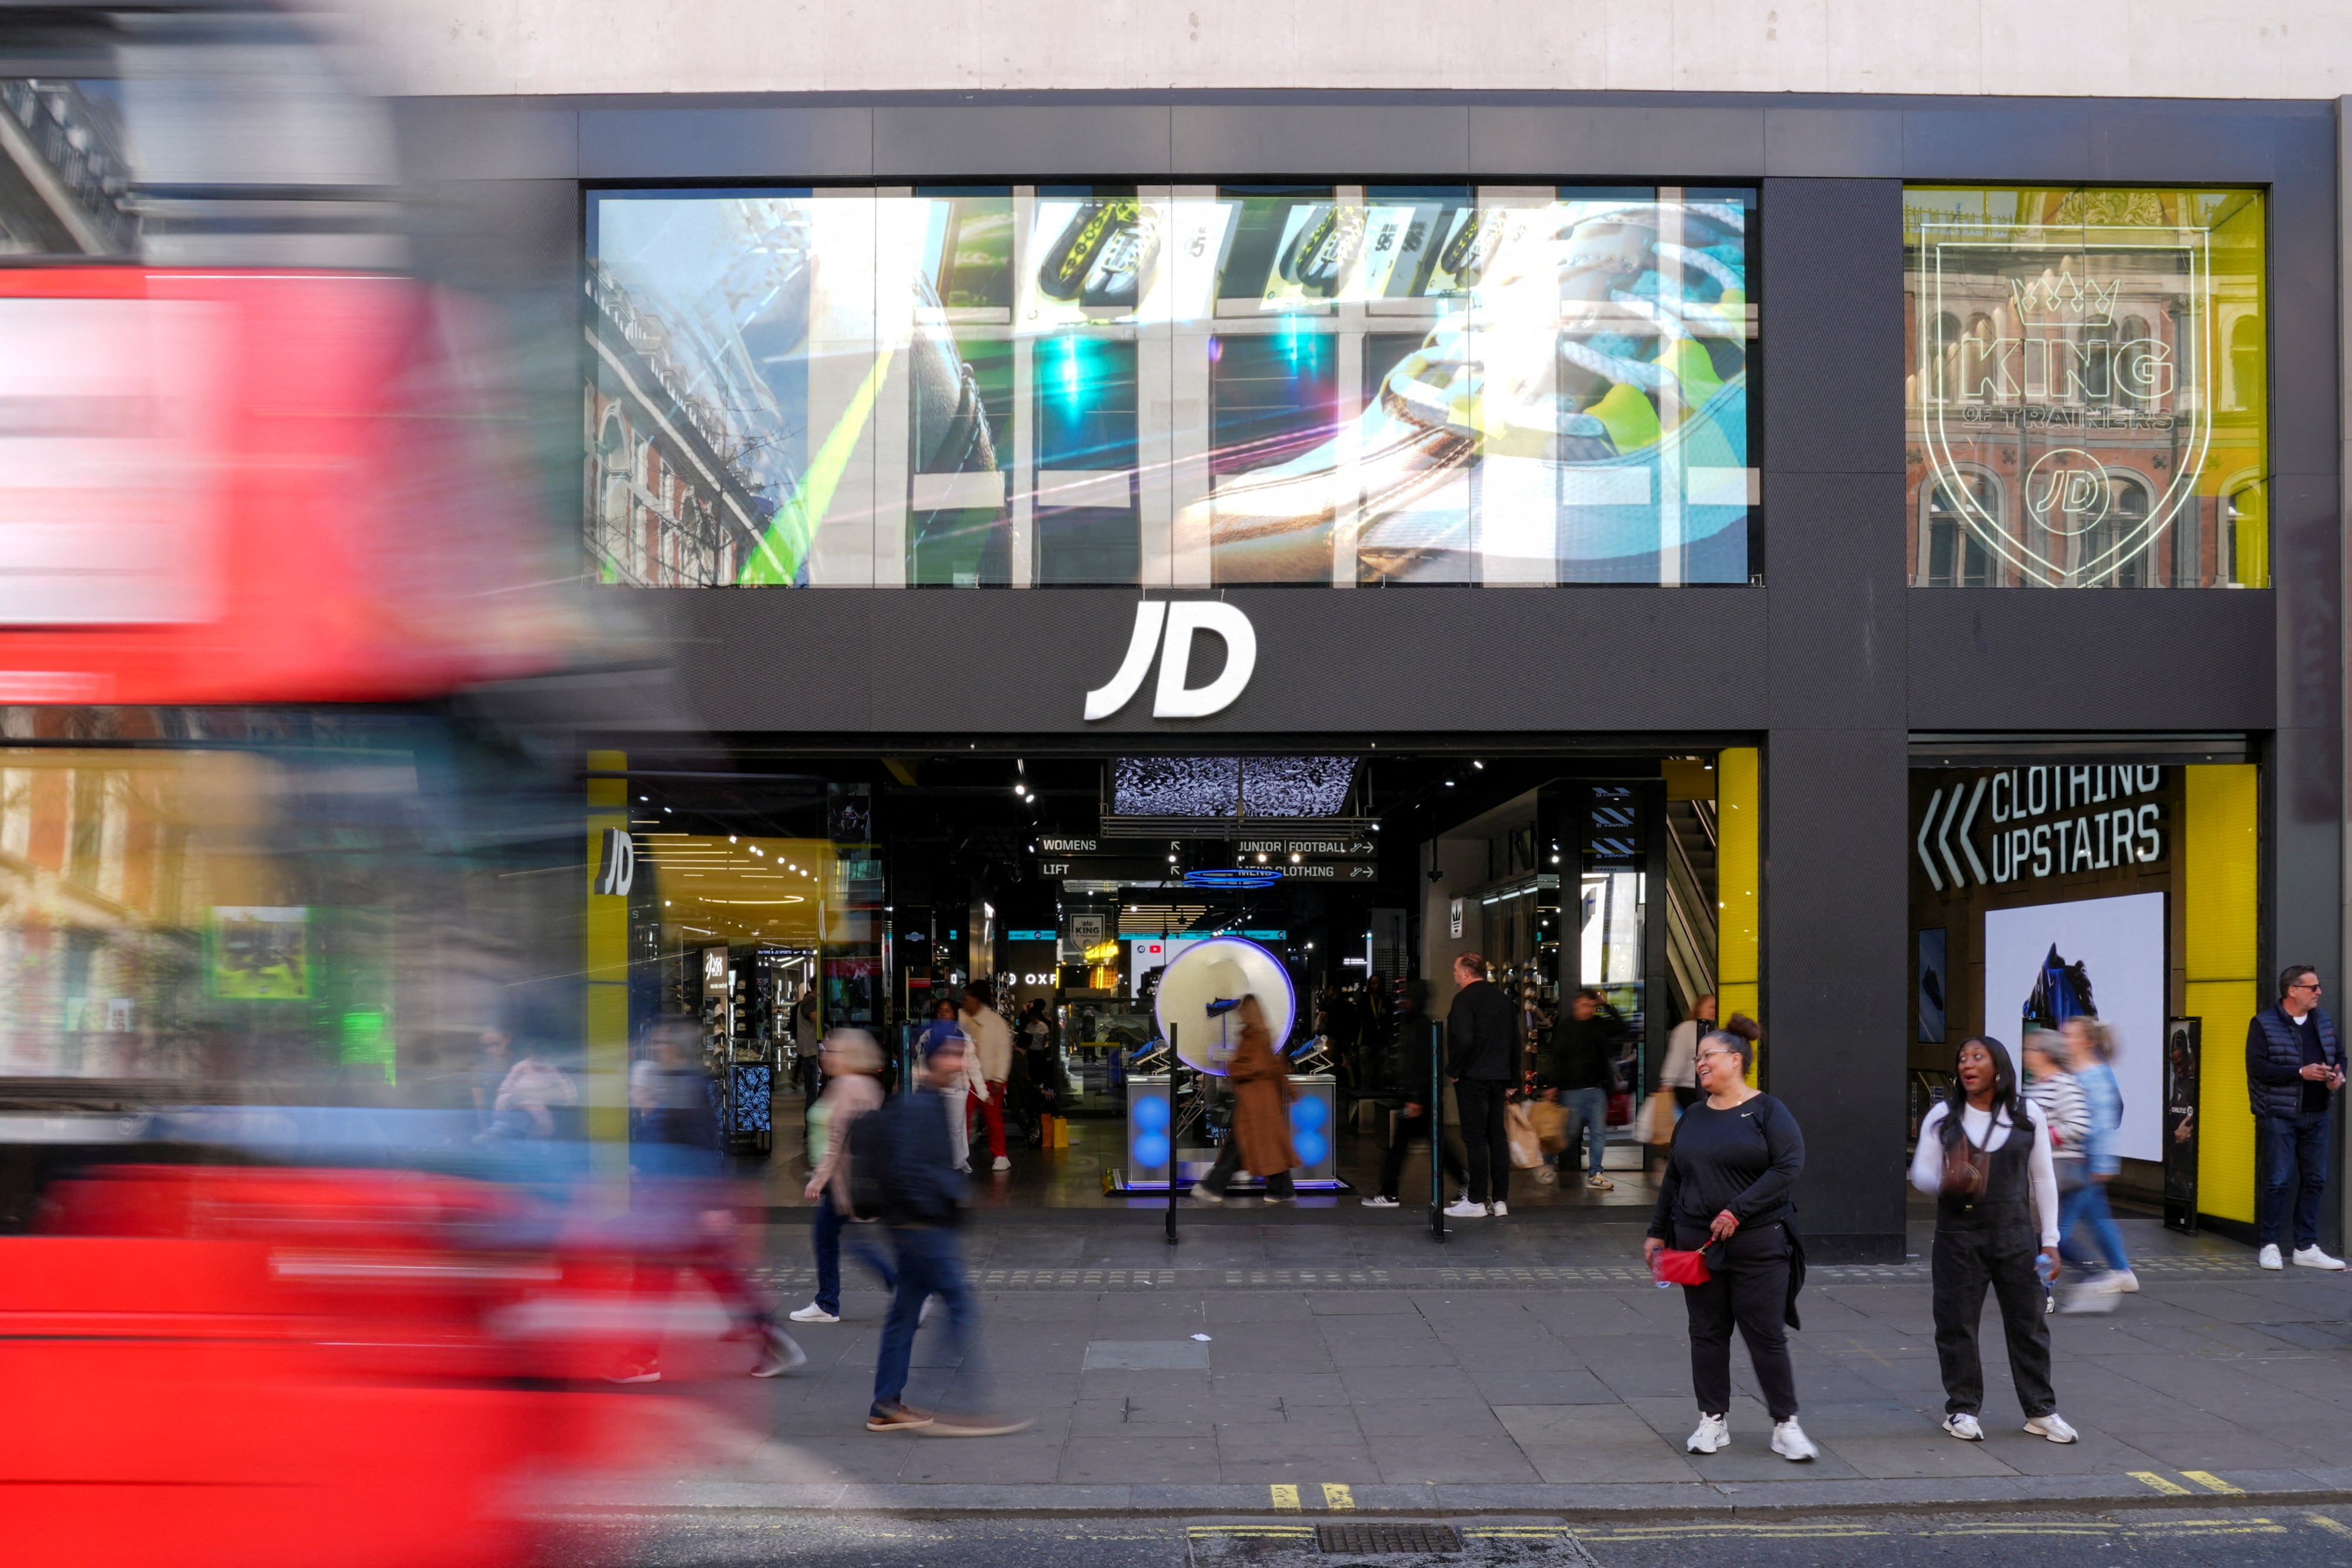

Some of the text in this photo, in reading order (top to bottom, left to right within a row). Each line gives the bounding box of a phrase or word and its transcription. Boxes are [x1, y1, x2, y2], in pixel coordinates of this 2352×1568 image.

[1375, 233, 1395, 252] 95
[1962, 338, 2174, 399] KING
[1962, 405, 2174, 430] OF TRAINERS
[2036, 470, 2098, 513] JD
[1084, 601, 1257, 720] JD
[1043, 839, 1097, 850] WOMENS
[1238, 841, 1345, 852] JUNIOR FOOTBALL
[1993, 803, 2159, 883] UPSTAIRS
[604, 828, 634, 896] JD
[1043, 864, 1069, 874] LIFT
